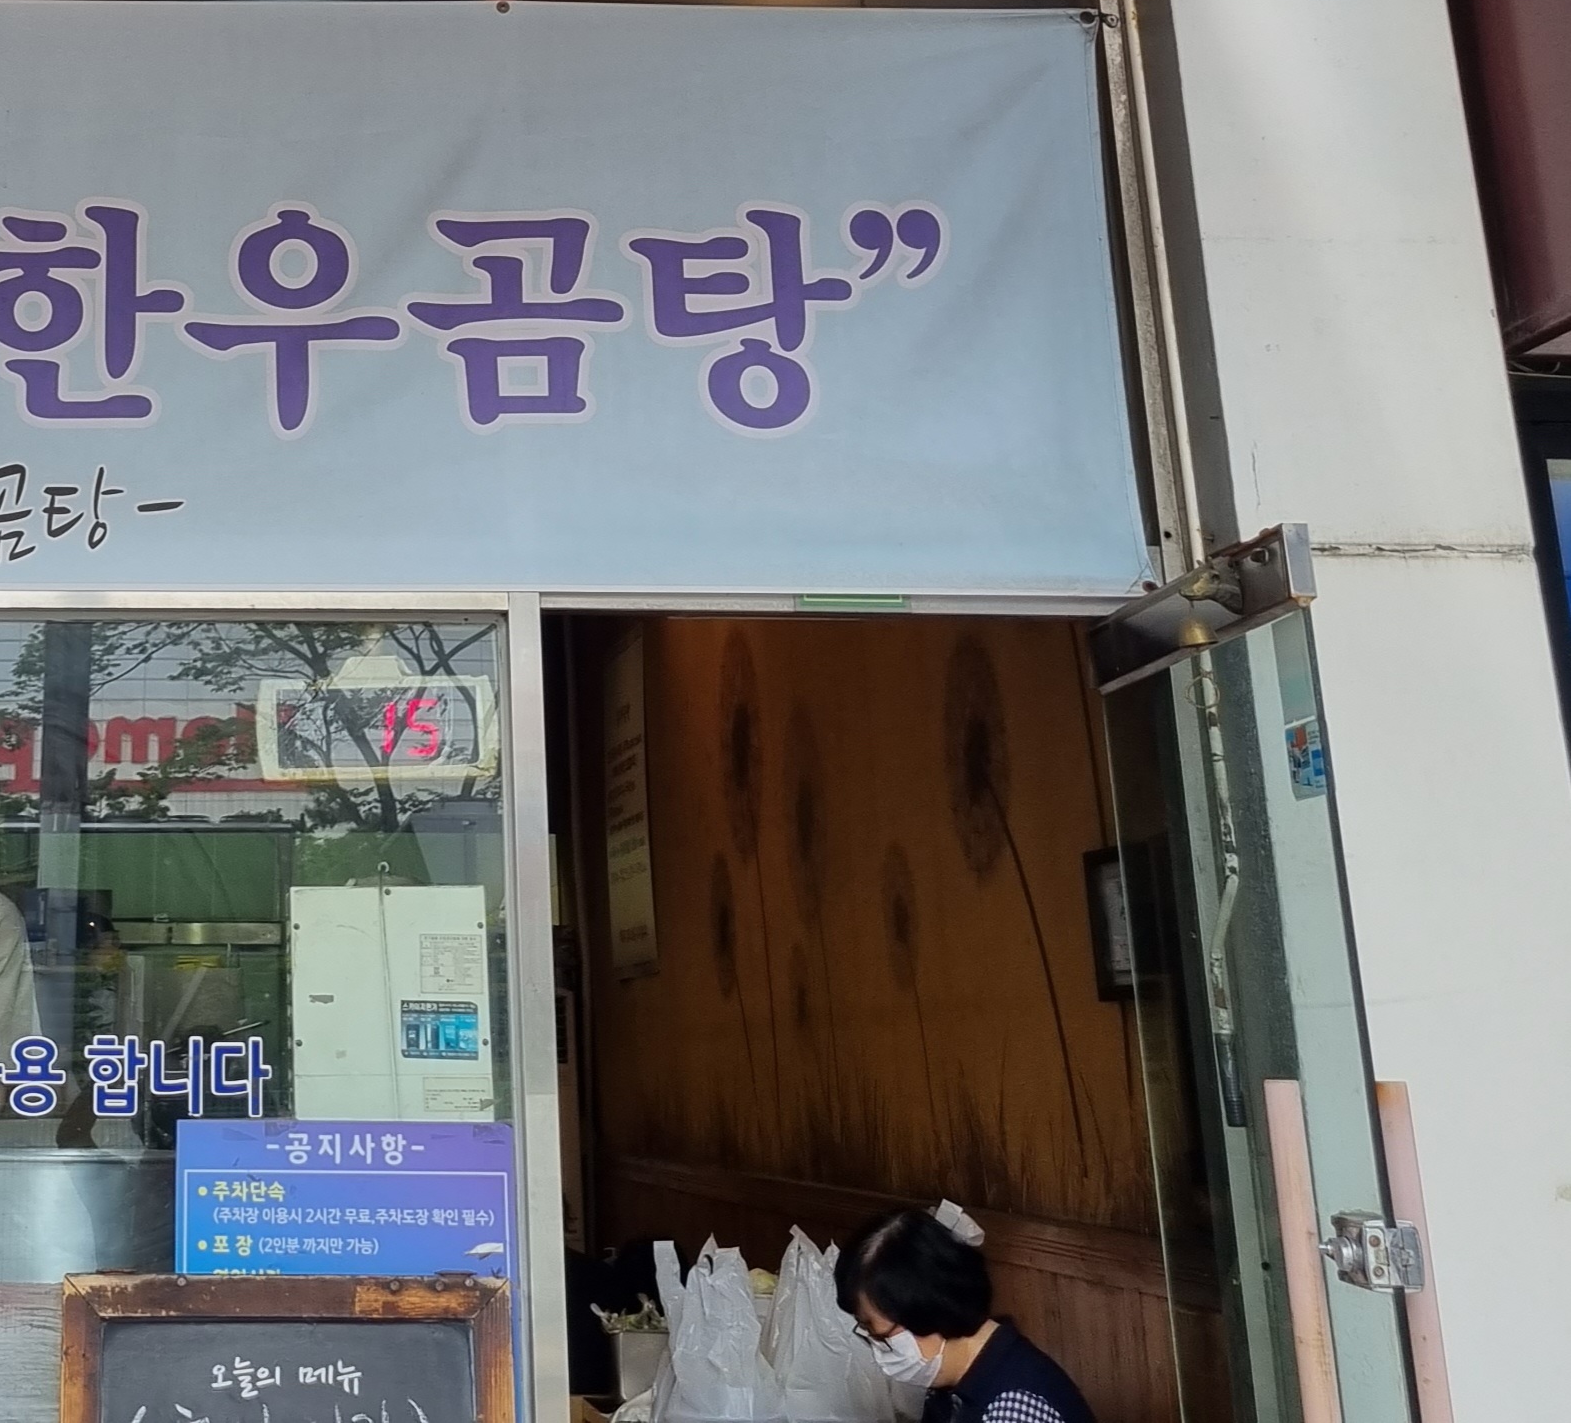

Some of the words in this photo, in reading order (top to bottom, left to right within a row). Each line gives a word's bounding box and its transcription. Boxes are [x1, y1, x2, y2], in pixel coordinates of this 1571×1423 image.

[383, 698, 439, 756] 15
[82, 1033, 273, 1119] 합니다
[212, 1181, 286, 1203] 주차단속
[213, 1207, 259, 1225] (주차장
[262, 1207, 302, 1225] 이용시
[305, 1208, 341, 1225] 2시간
[431, 1208, 458, 1226] 확인
[461, 1209, 495, 1227] 필수)
[258, 1237, 300, 1255] (2인분
[302, 1237, 343, 1255] 까지만
[345, 1237, 379, 1255] 가능)
[210, 1356, 281, 1398] 오늘의
[298, 1358, 362, 1396] 메뉴
